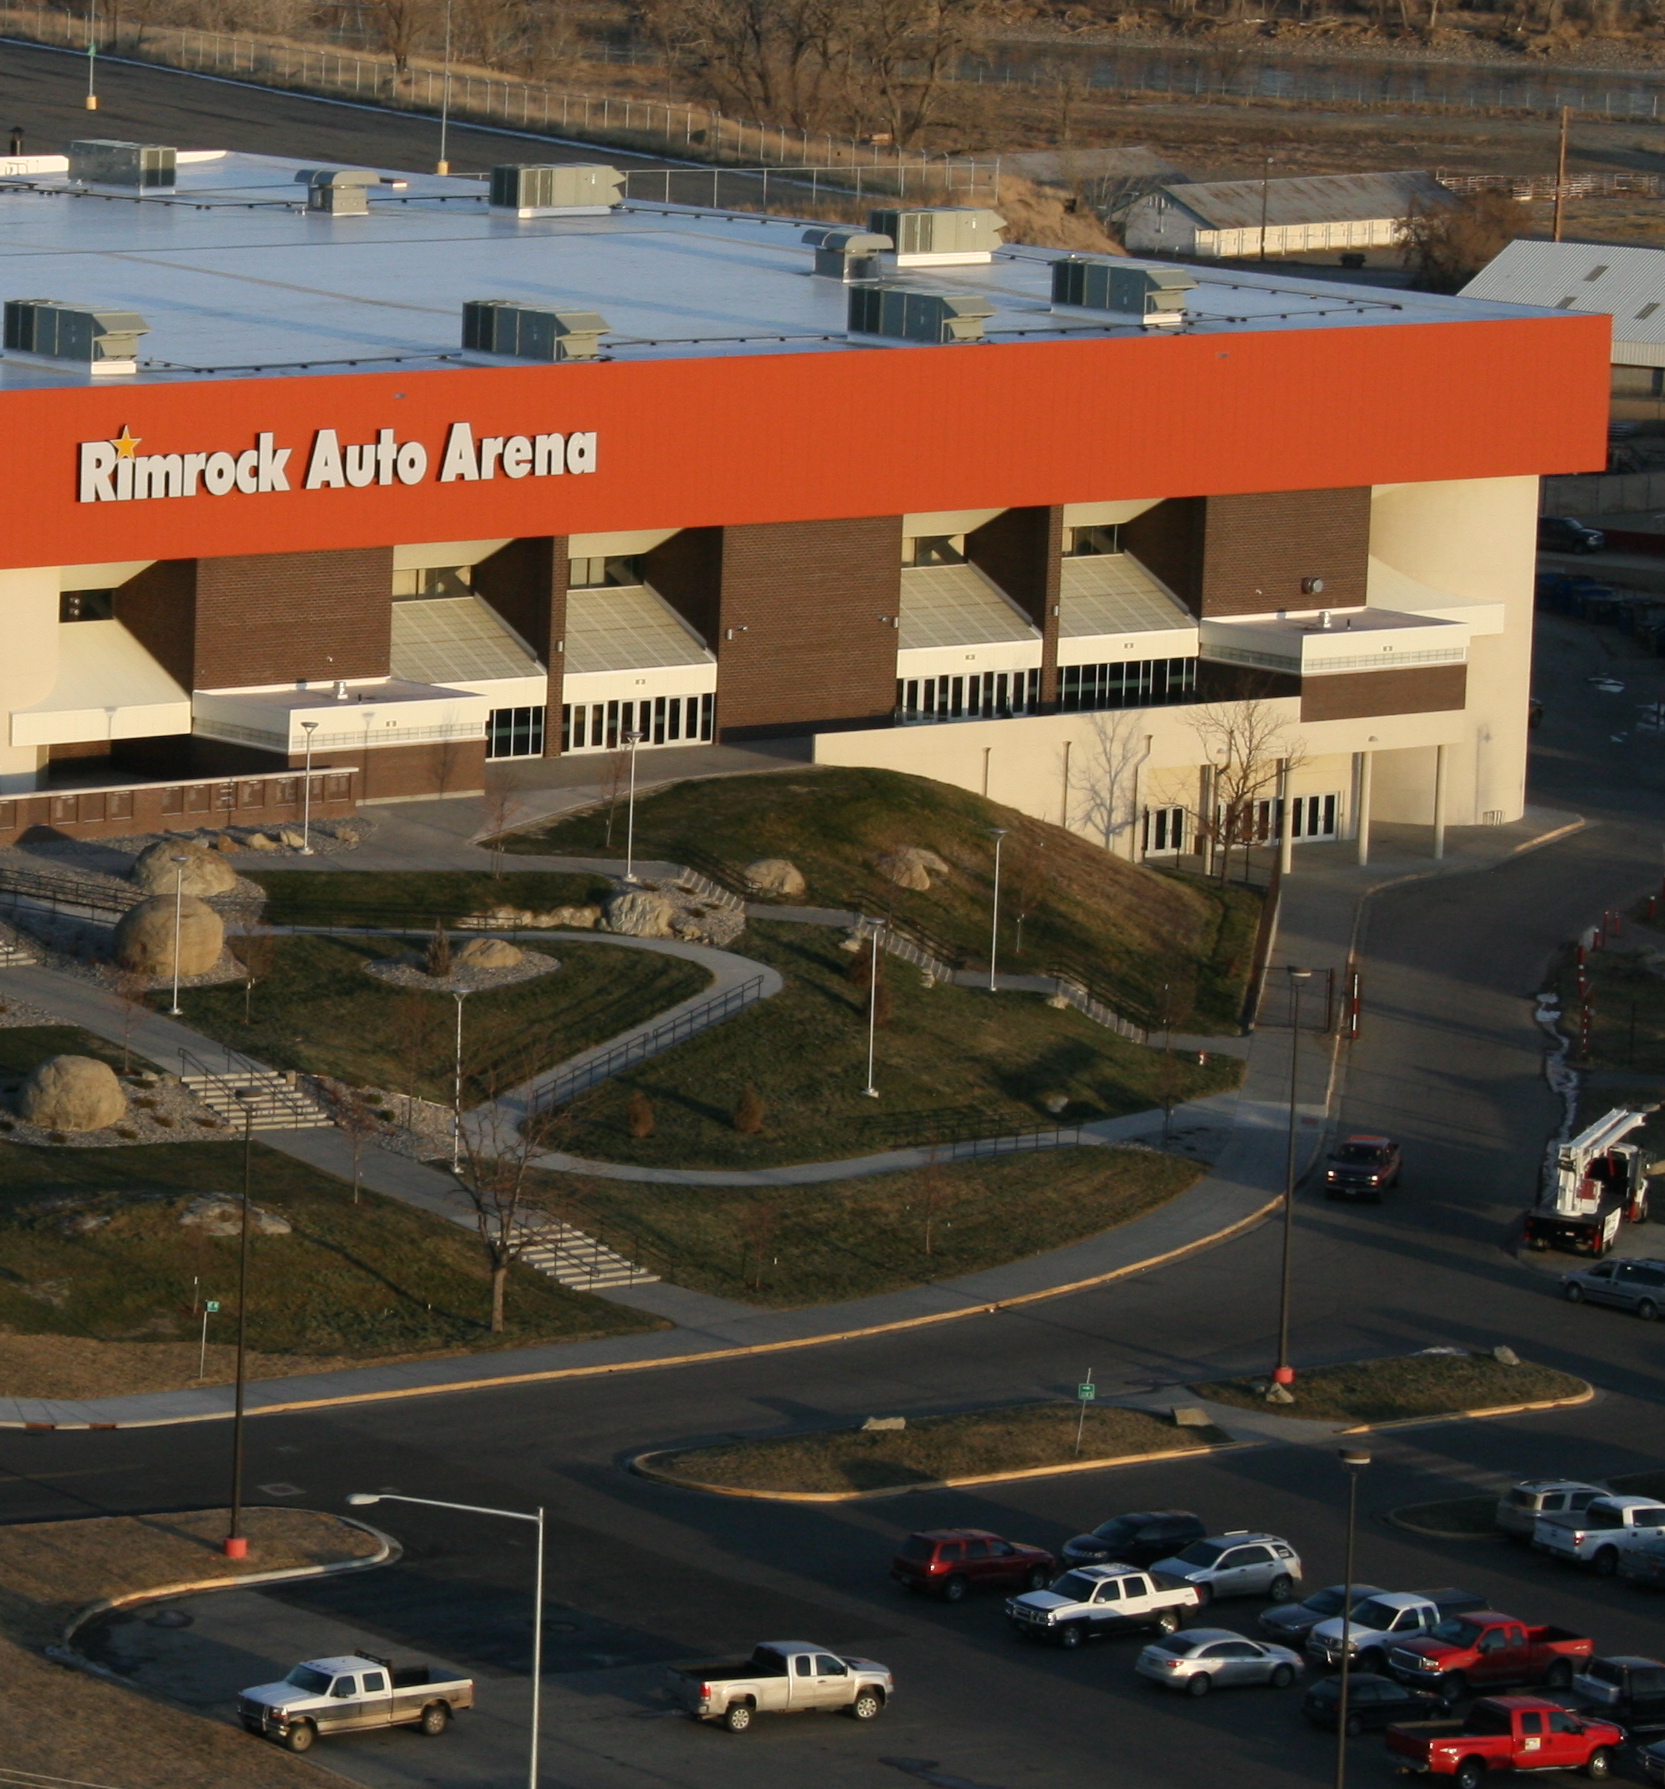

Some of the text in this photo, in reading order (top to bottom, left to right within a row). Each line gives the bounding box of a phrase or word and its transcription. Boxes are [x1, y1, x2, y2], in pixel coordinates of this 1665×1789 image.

[79, 421, 598, 503] Rimrock Auto Arena
